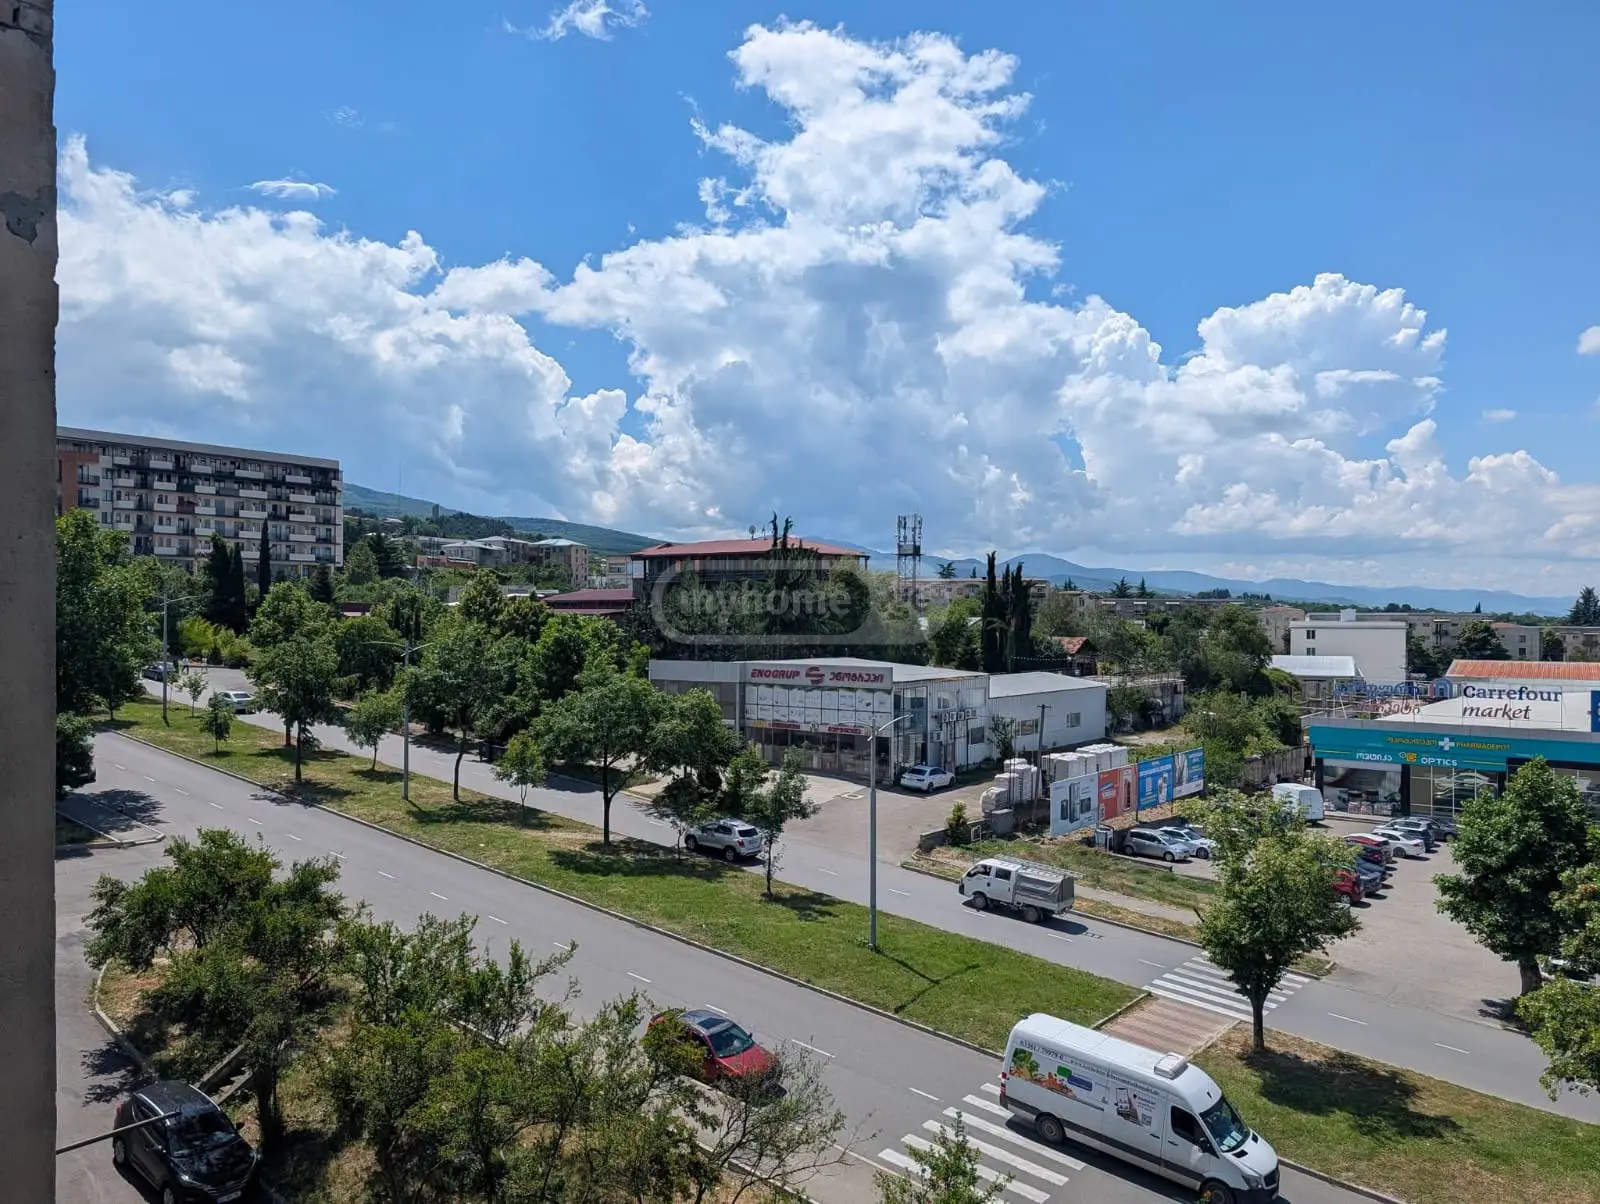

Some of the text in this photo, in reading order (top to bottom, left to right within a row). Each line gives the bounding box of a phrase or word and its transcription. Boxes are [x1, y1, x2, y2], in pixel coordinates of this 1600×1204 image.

[750, 669, 800, 679] ENOGRUP
[1463, 685, 1562, 702] Carrefour
[1462, 703, 1532, 720] market
[1456, 742, 1510, 751] PHARMADEPOT
[1421, 757, 1458, 767] OPTICS
